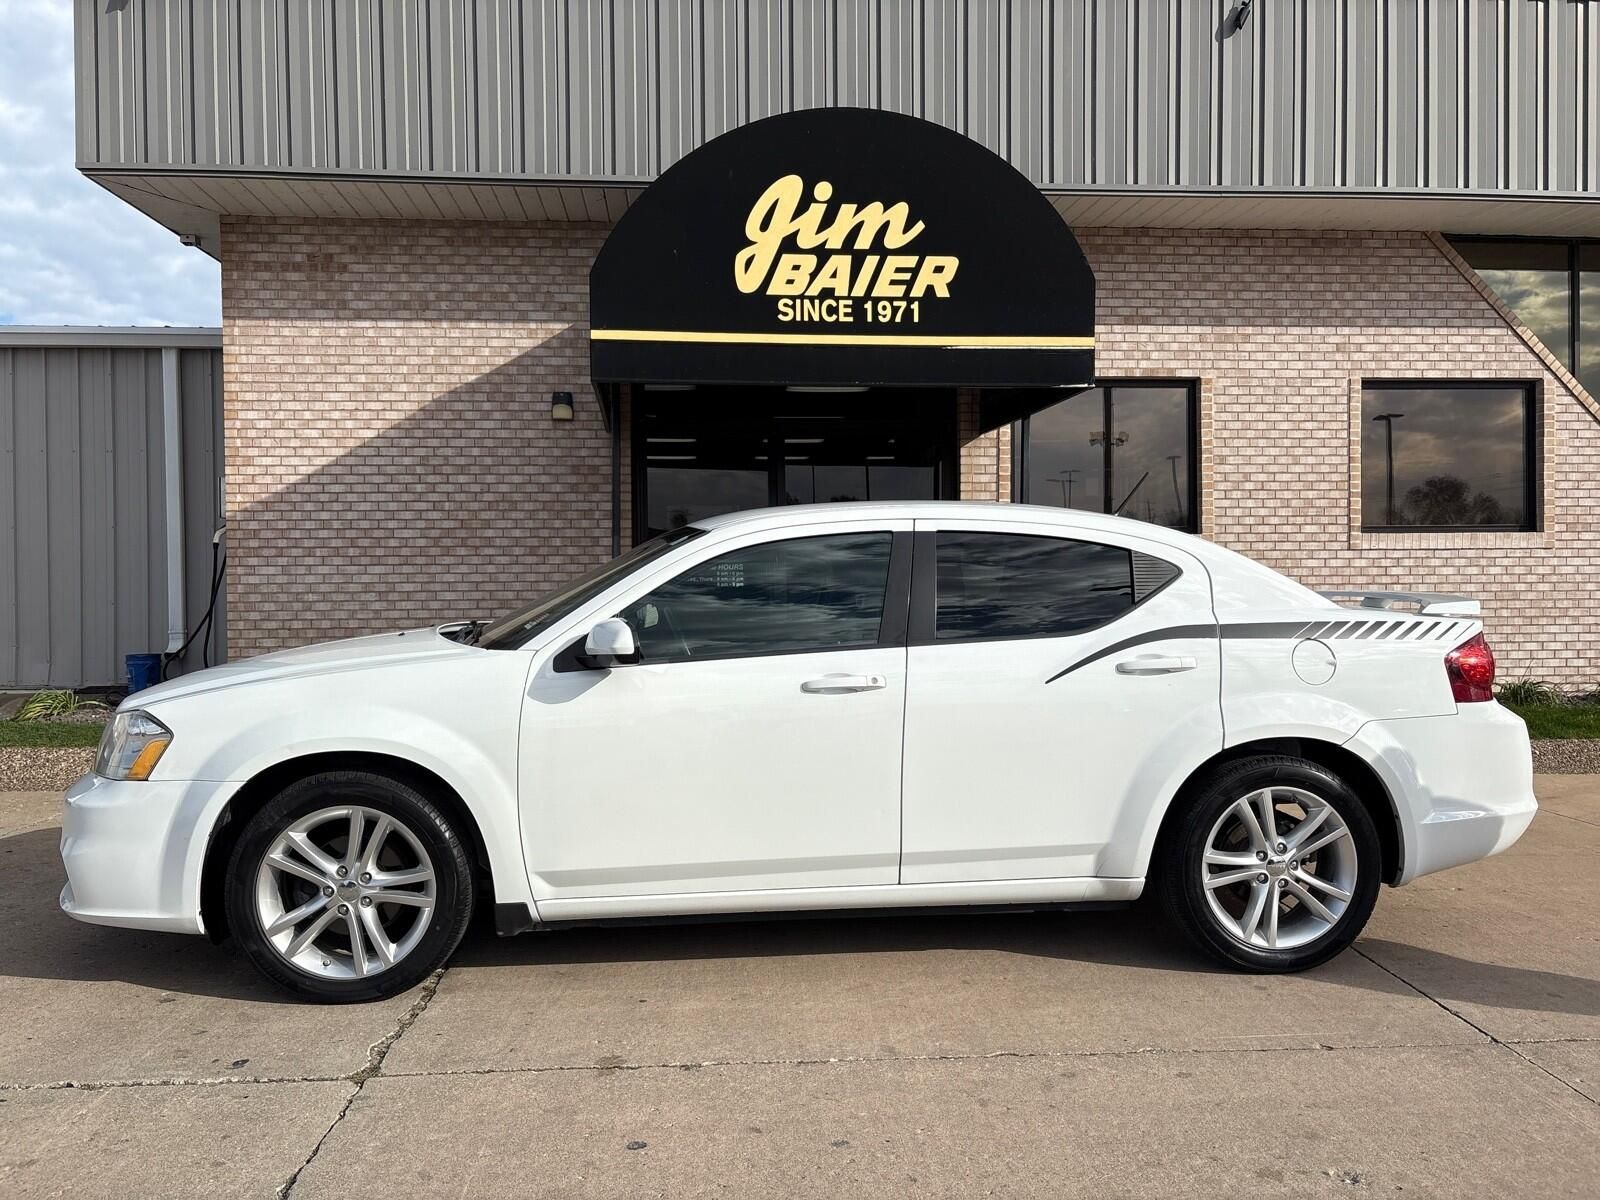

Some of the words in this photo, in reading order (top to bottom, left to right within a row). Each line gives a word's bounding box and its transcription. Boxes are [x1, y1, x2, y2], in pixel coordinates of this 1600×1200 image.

[734, 174, 926, 294] Jim
[765, 253, 960, 298] BAIER
[777, 298, 854, 322] SINCE
[863, 300, 919, 323] 1971
